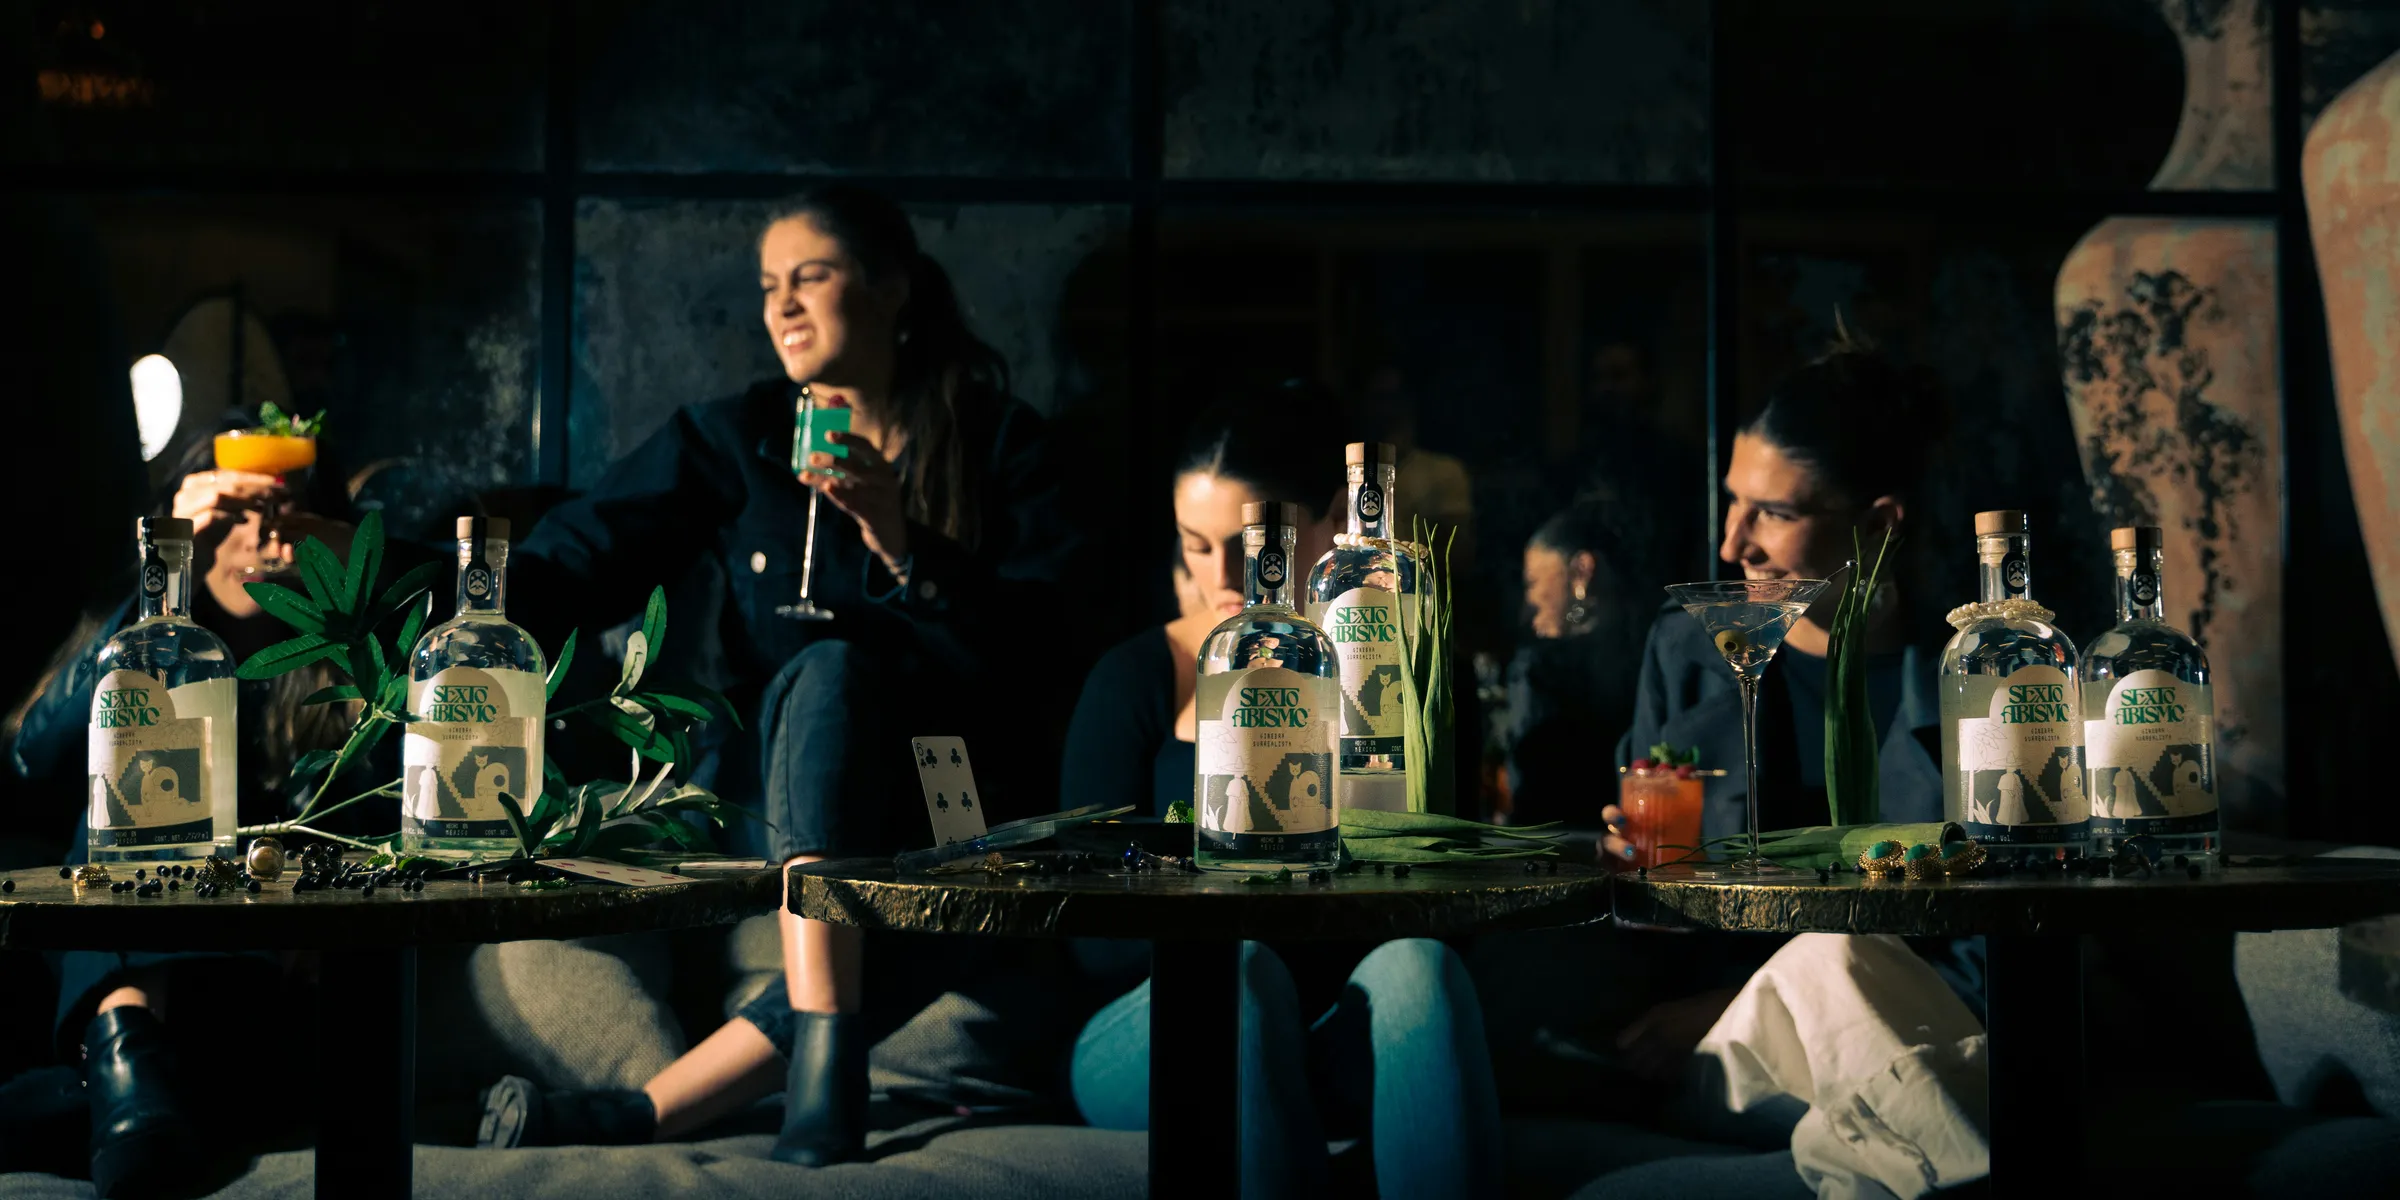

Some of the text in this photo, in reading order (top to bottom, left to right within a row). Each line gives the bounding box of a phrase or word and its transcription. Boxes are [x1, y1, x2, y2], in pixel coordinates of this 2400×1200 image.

[1336, 606, 1388, 624] SEXTO
[1330, 624, 1397, 642] ABISMO
[100, 688, 149, 709] SEXTO
[433, 685, 488, 703] SEXTO
[1240, 688, 1299, 707] SEXTO
[2008, 684, 2063, 704] SEXTO
[2120, 687, 2176, 706] SEXTO
[96, 707, 161, 729] ABISMO
[426, 704, 497, 723] ABISMO
[1231, 707, 1309, 728] ABISMO
[2001, 704, 2071, 724] ABISMO
[2114, 704, 2185, 725] ABISMO
